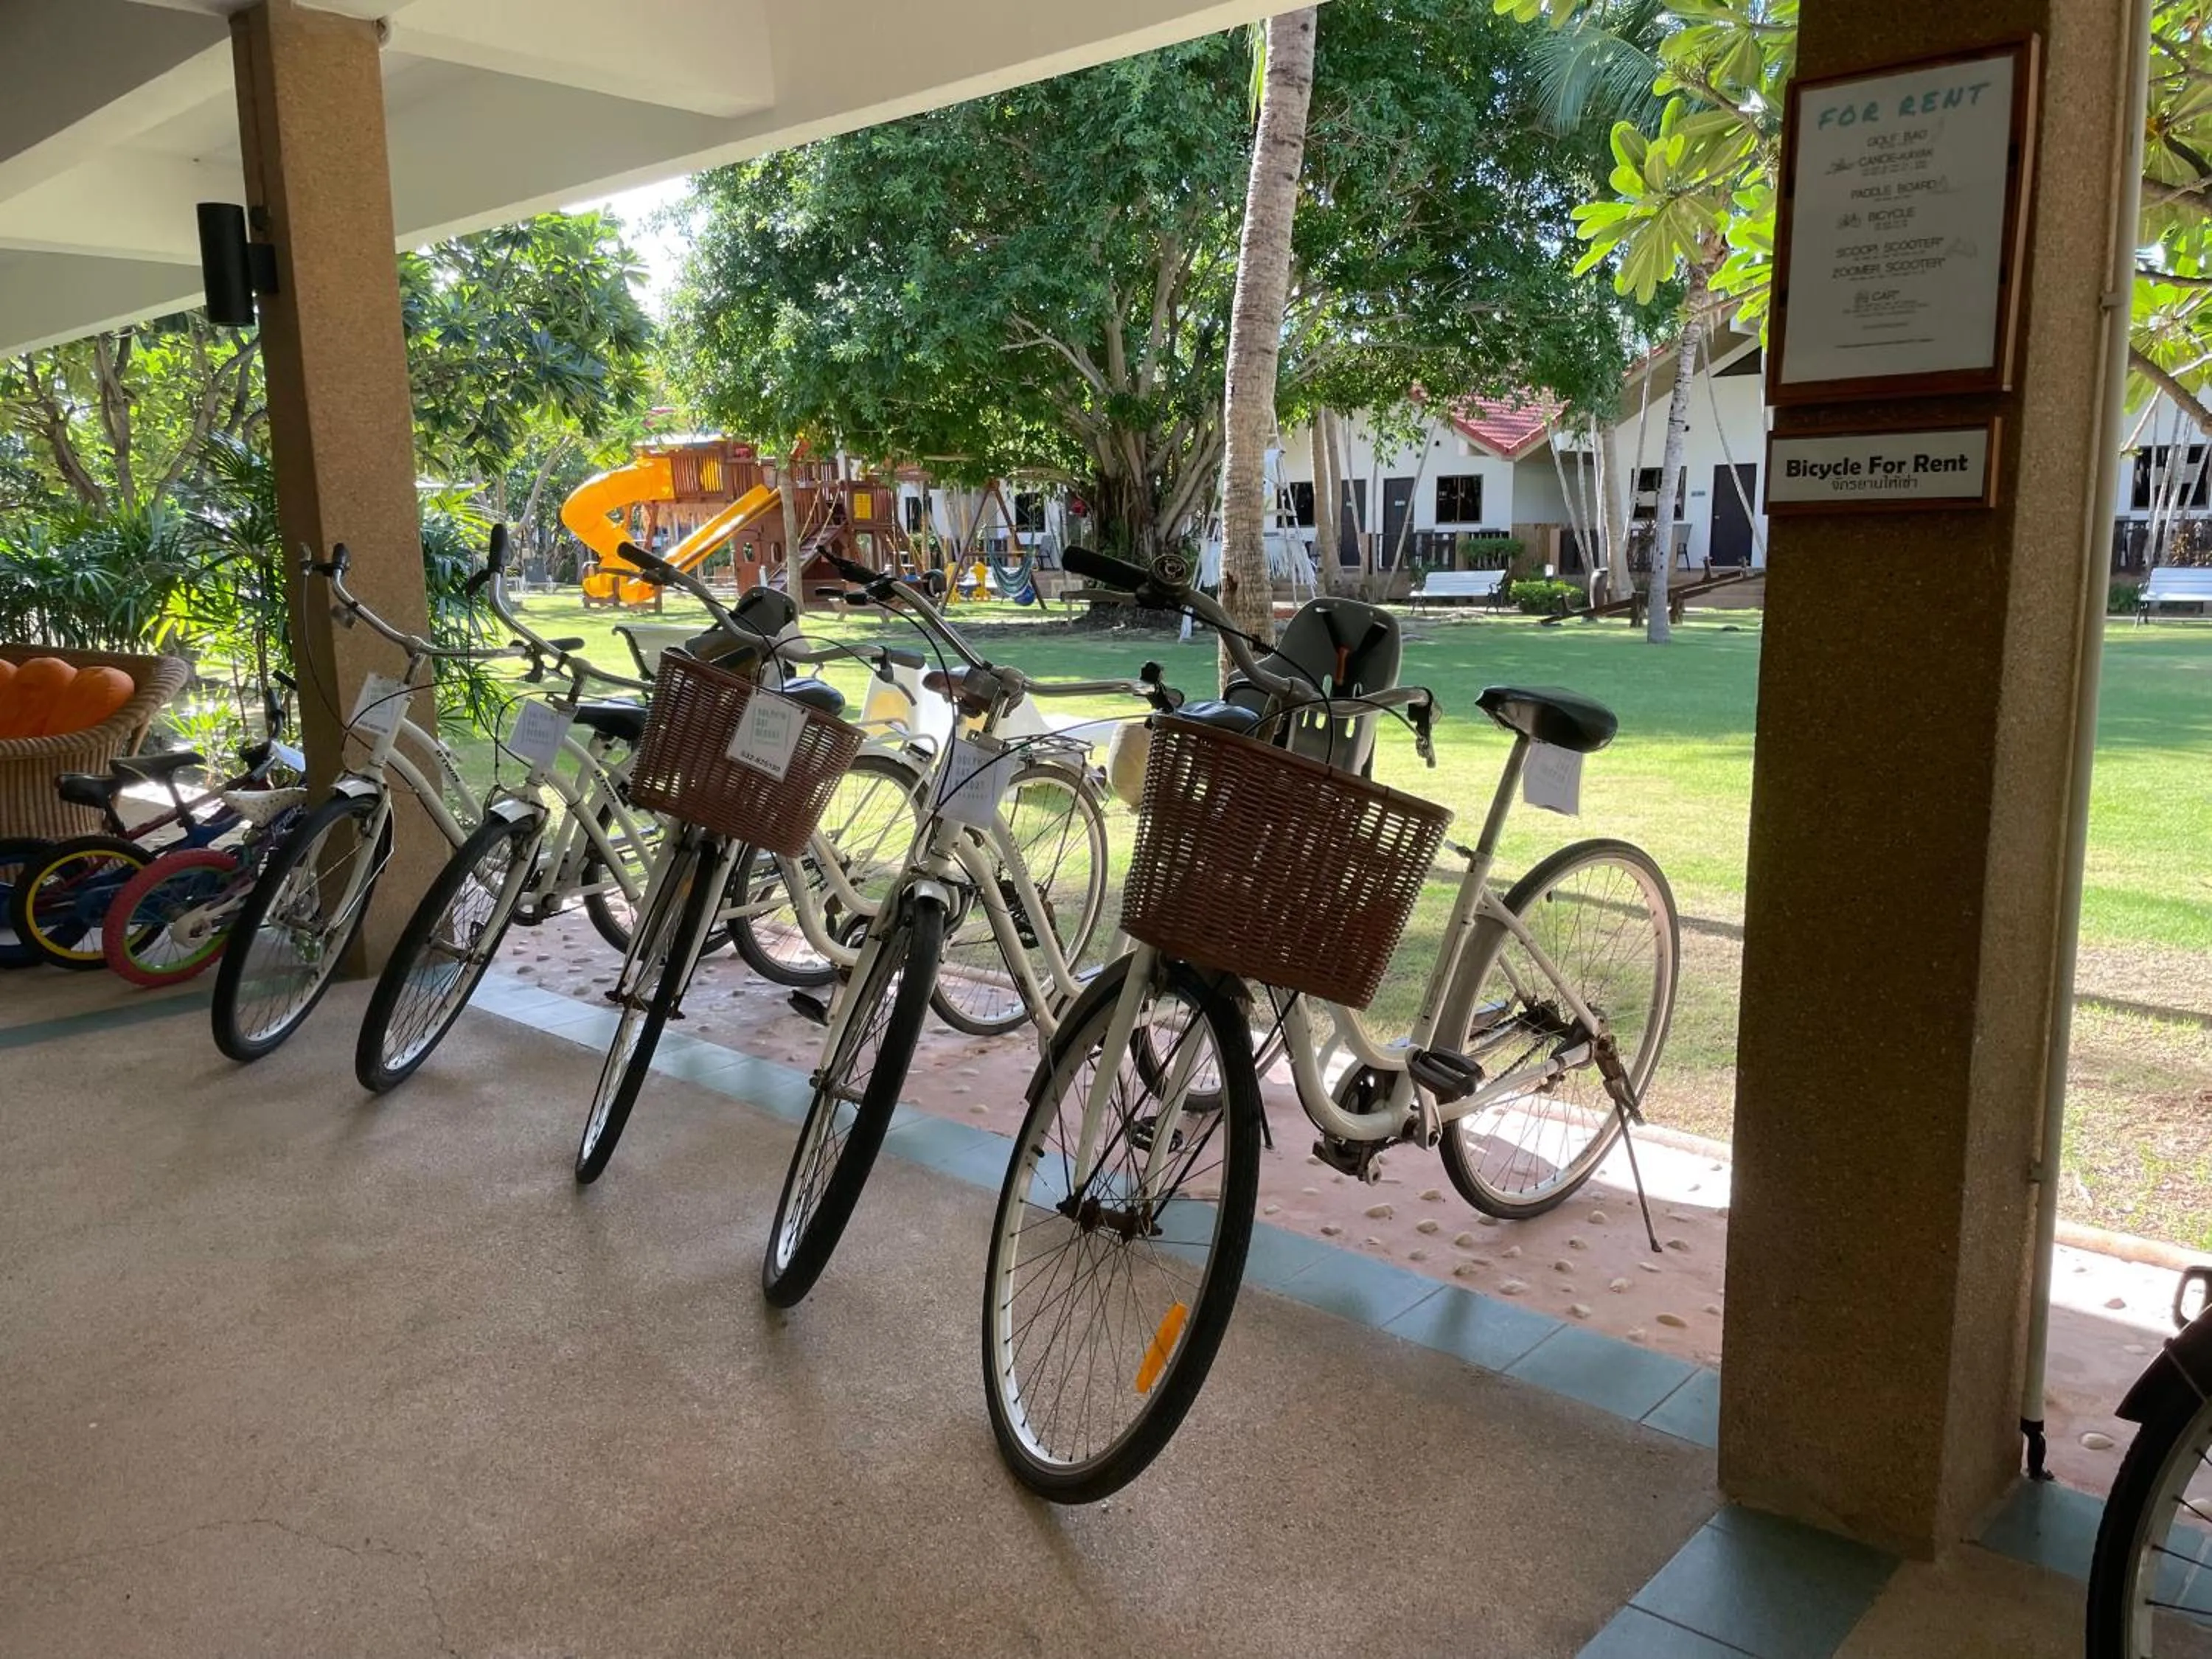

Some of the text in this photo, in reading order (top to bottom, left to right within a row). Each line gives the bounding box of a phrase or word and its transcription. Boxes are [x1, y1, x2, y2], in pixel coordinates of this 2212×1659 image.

[1818, 82, 1992, 131] FOR RENT
[1851, 184, 1892, 200] PADDLE
[1897, 178, 1937, 194] BOARD
[1868, 206, 1916, 222] BICYCLE
[1786, 453, 1969, 480] Bicycle For Rent
